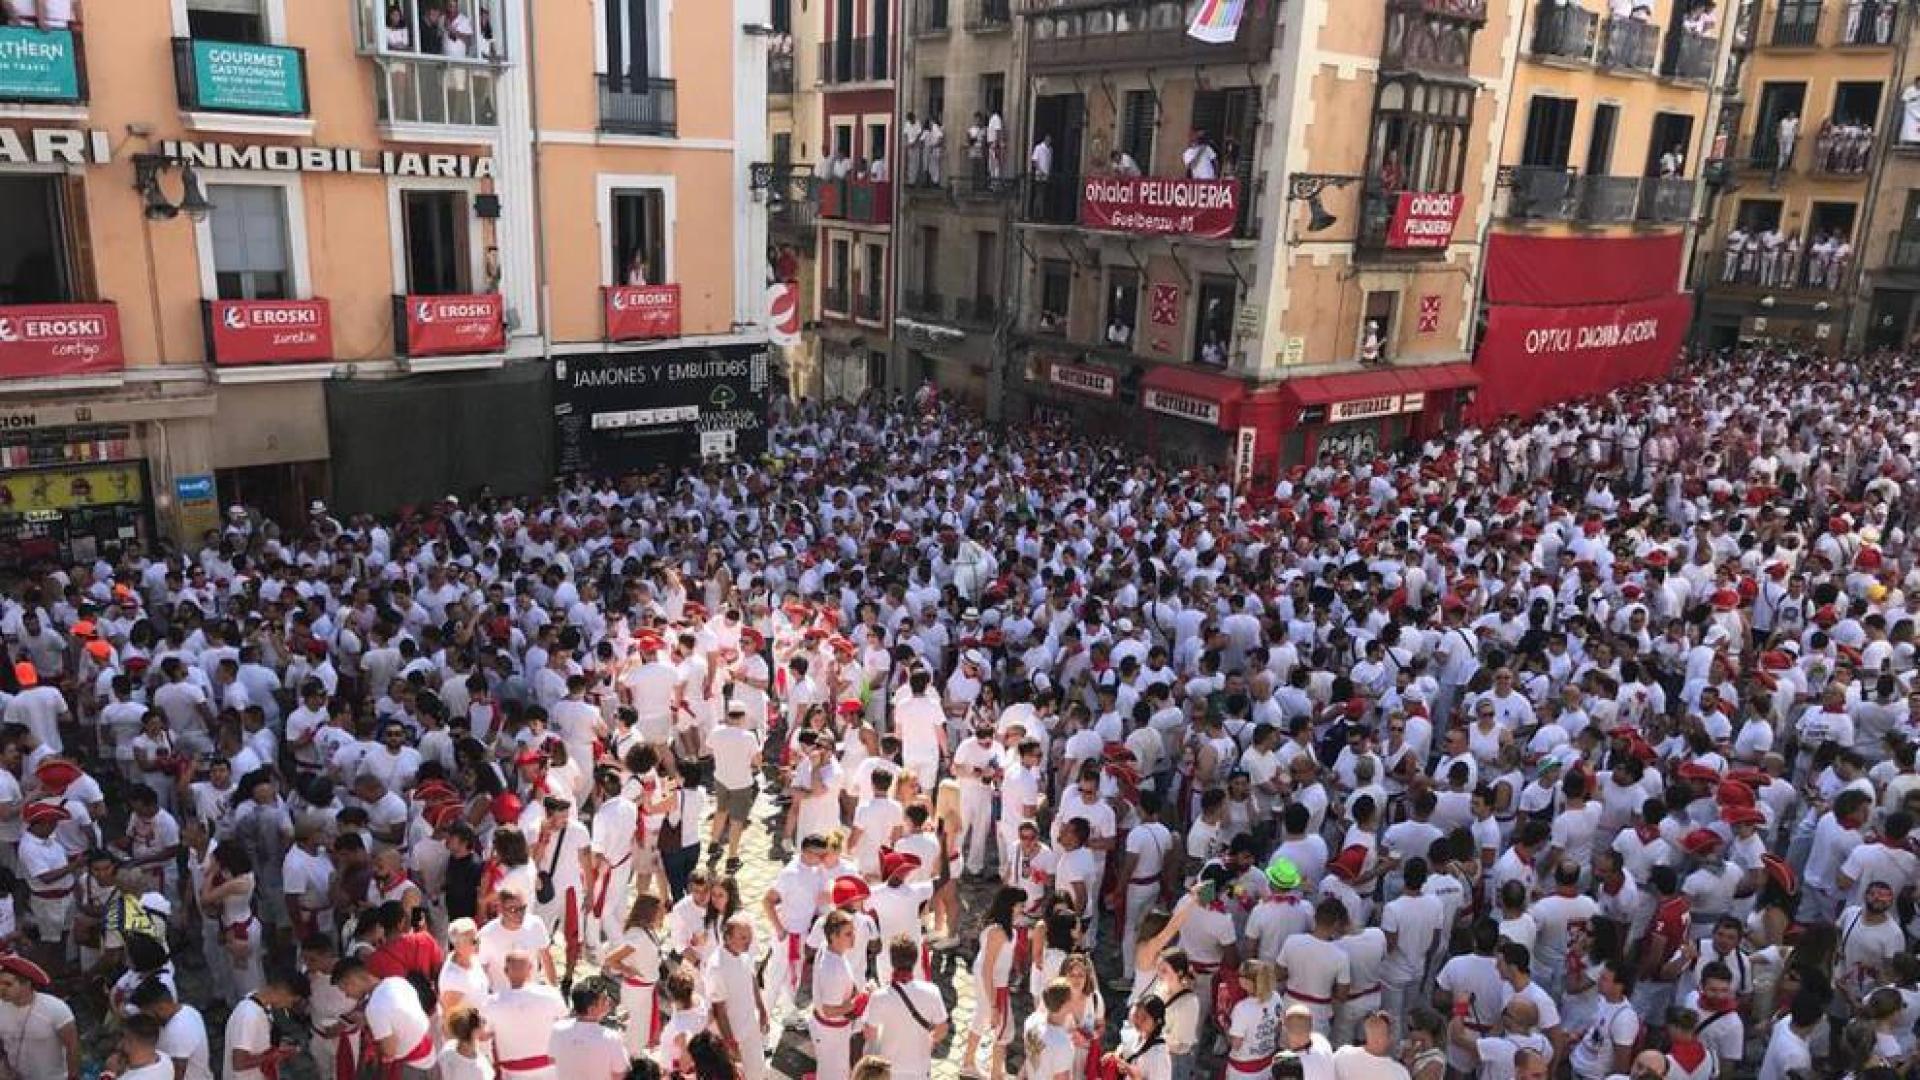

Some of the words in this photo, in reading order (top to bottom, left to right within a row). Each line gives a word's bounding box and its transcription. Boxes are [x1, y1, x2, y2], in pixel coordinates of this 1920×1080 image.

[209, 50, 284, 68] GOURMET
[629, 293, 672, 306] EROSKI
[252, 308, 316, 324] EROSKI
[440, 304, 493, 318] EROSKI
[26, 320, 101, 337] EROSKI
[573, 365, 647, 388] JAMONES
[650, 364, 662, 382] Y
[668, 359, 748, 382] EMBUTIDOS
[0, 412, 36, 428] IÓN
